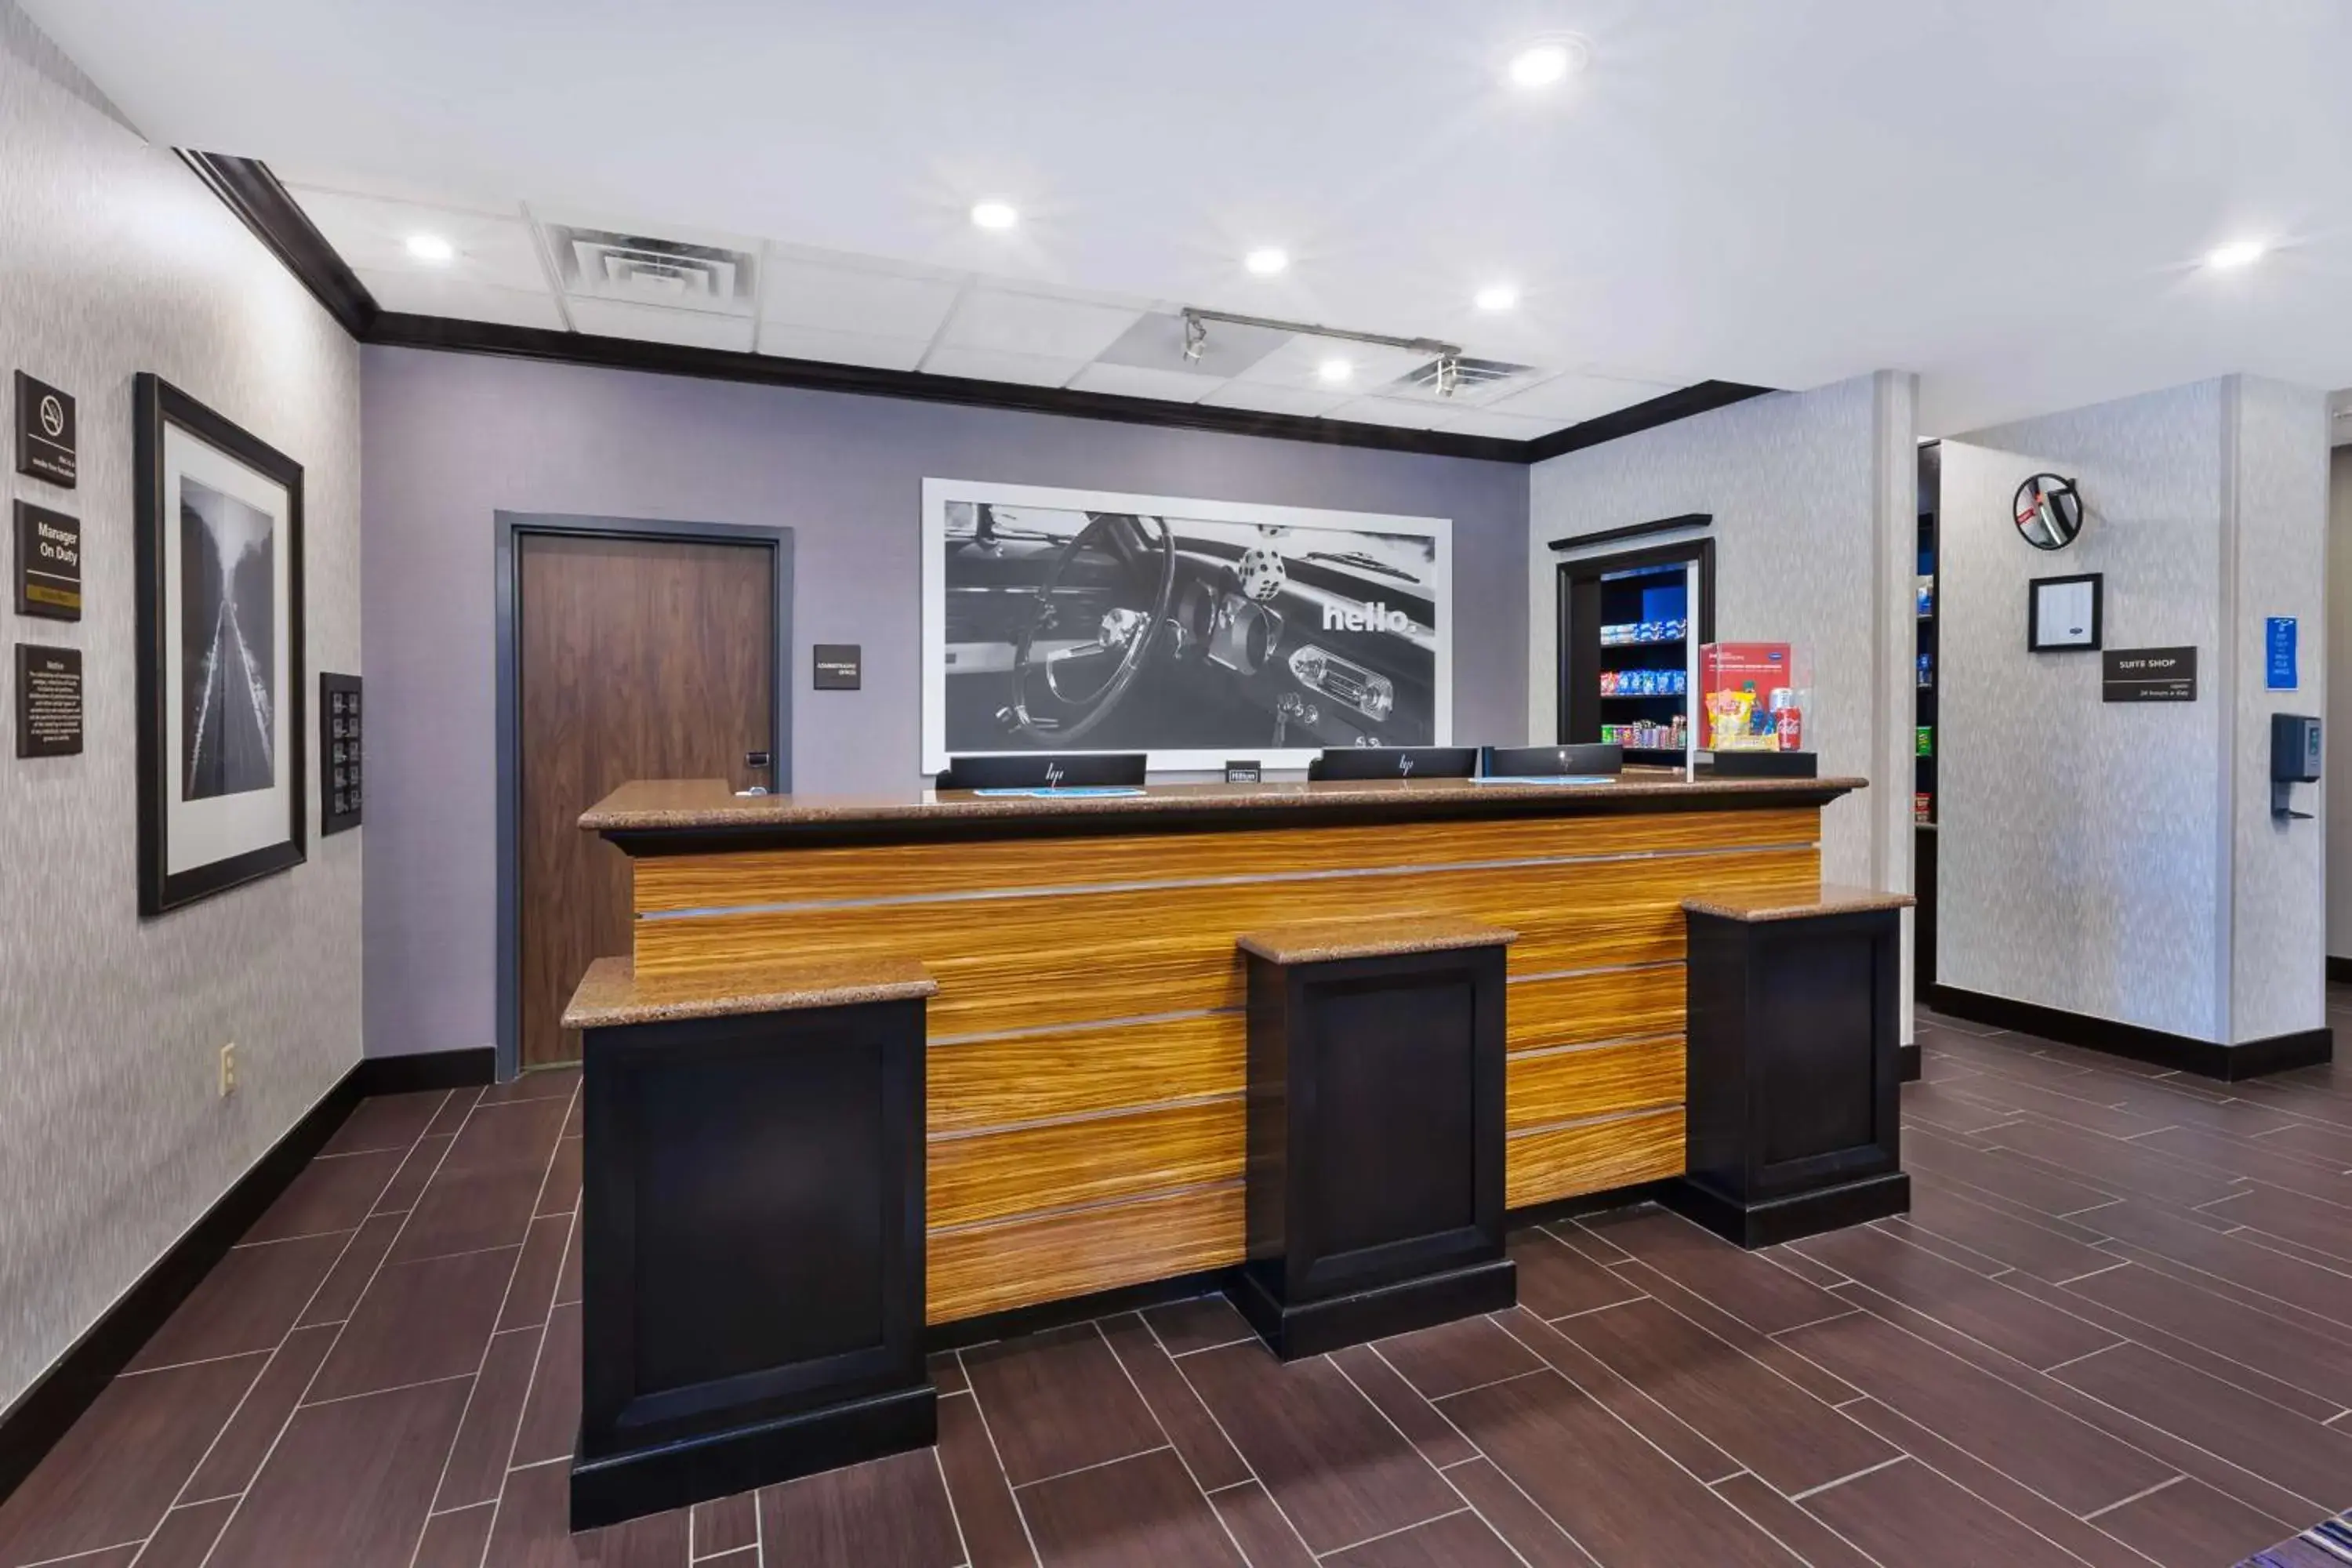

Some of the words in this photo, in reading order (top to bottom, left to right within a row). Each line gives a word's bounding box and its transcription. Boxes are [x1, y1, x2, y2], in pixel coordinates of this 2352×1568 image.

[38, 521, 78, 546] Manager
[40, 542, 55, 558] On
[56, 545, 78, 567] Duty
[1323, 601, 1417, 633] hello.
[2119, 659, 2146, 670] SUITE
[2148, 659, 2176, 668] SHOP
[1045, 762, 1064, 788] hp
[1399, 753, 1414, 776] hp
